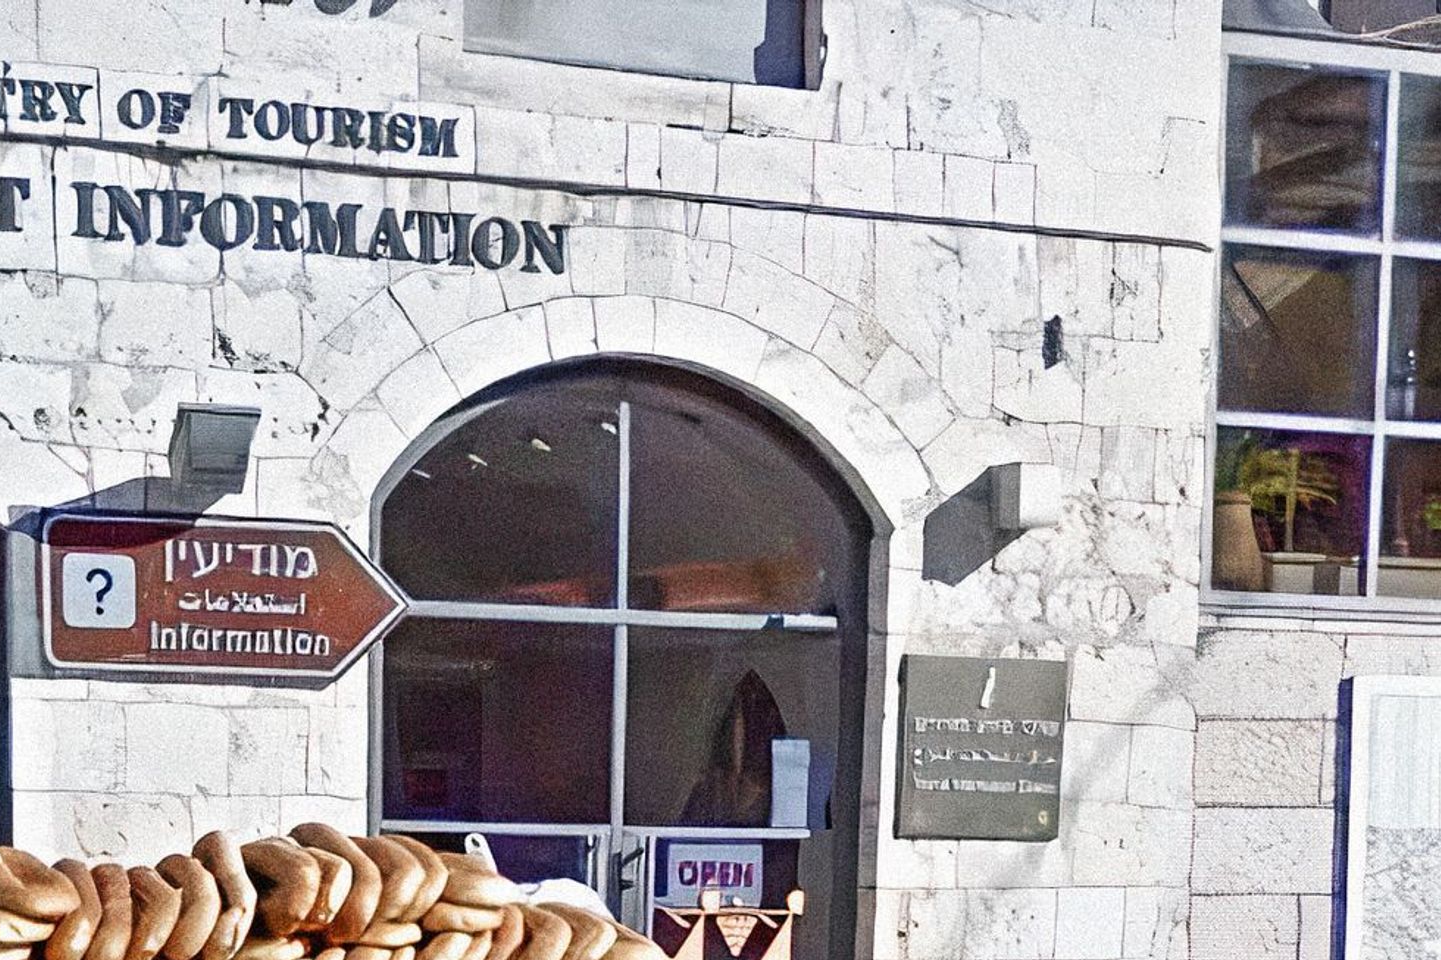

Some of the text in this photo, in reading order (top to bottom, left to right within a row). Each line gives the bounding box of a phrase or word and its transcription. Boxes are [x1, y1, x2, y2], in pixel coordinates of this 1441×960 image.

[116, 87, 192, 135] OF
[218, 96, 462, 160] TOURISM
[70, 181, 570, 276] INFORMATION
[165, 538, 319, 582] מודיעין
[150, 620, 330, 656] Information
[677, 860, 754, 888] OPEN
